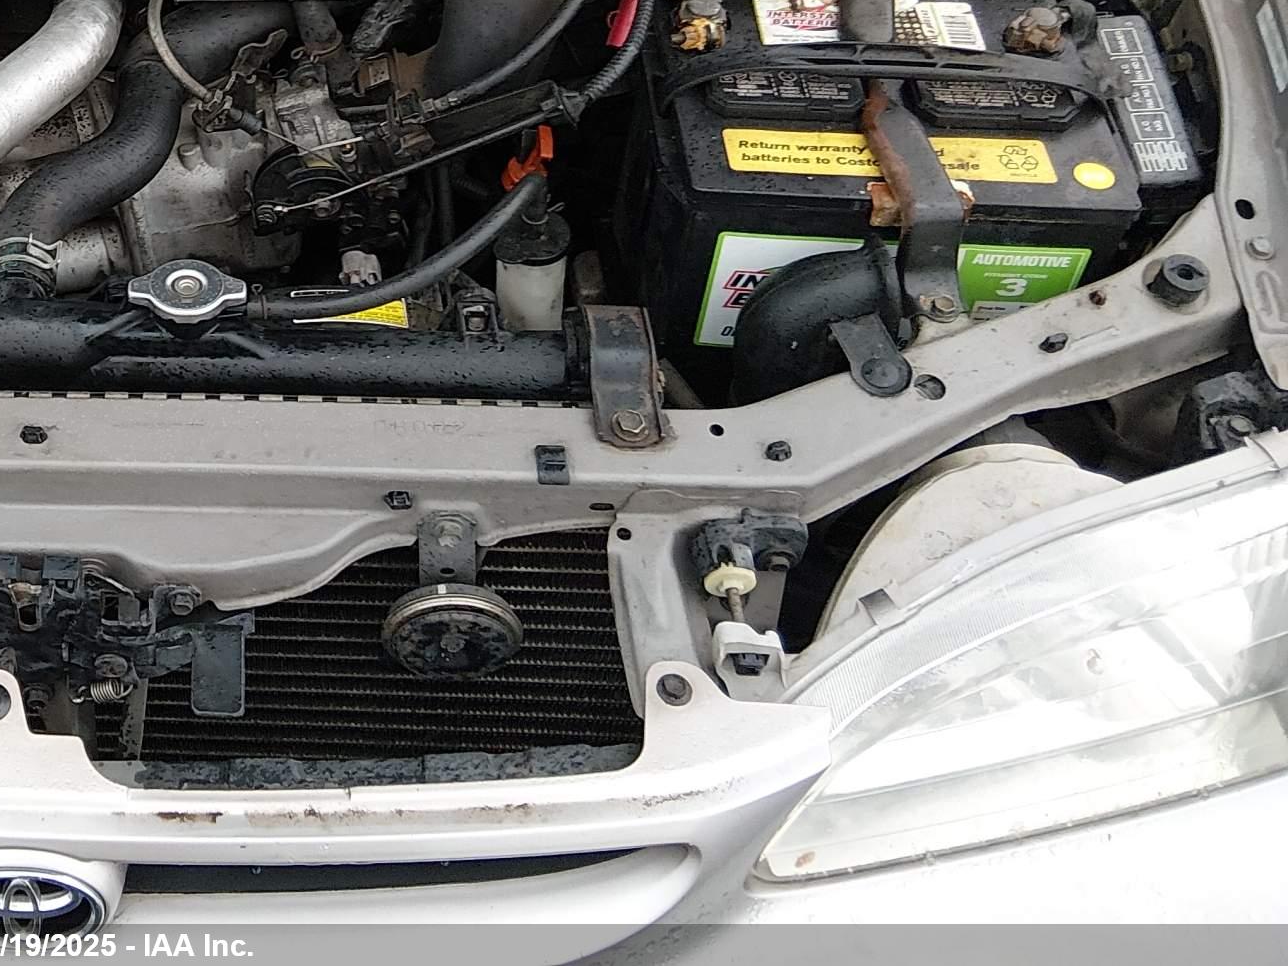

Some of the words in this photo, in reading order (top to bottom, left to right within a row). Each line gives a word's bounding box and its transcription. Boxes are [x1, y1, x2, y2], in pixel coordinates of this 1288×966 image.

[773, 18, 840, 27] BATTERIE
[738, 140, 791, 151] Return
[795, 144, 867, 155] warranty
[741, 153, 811, 164] batteries
[816, 156, 831, 165] to
[836, 156, 881, 167] Costc
[972, 252, 1072, 269] AUTOMOTIVE
[995, 278, 1028, 297] 3
